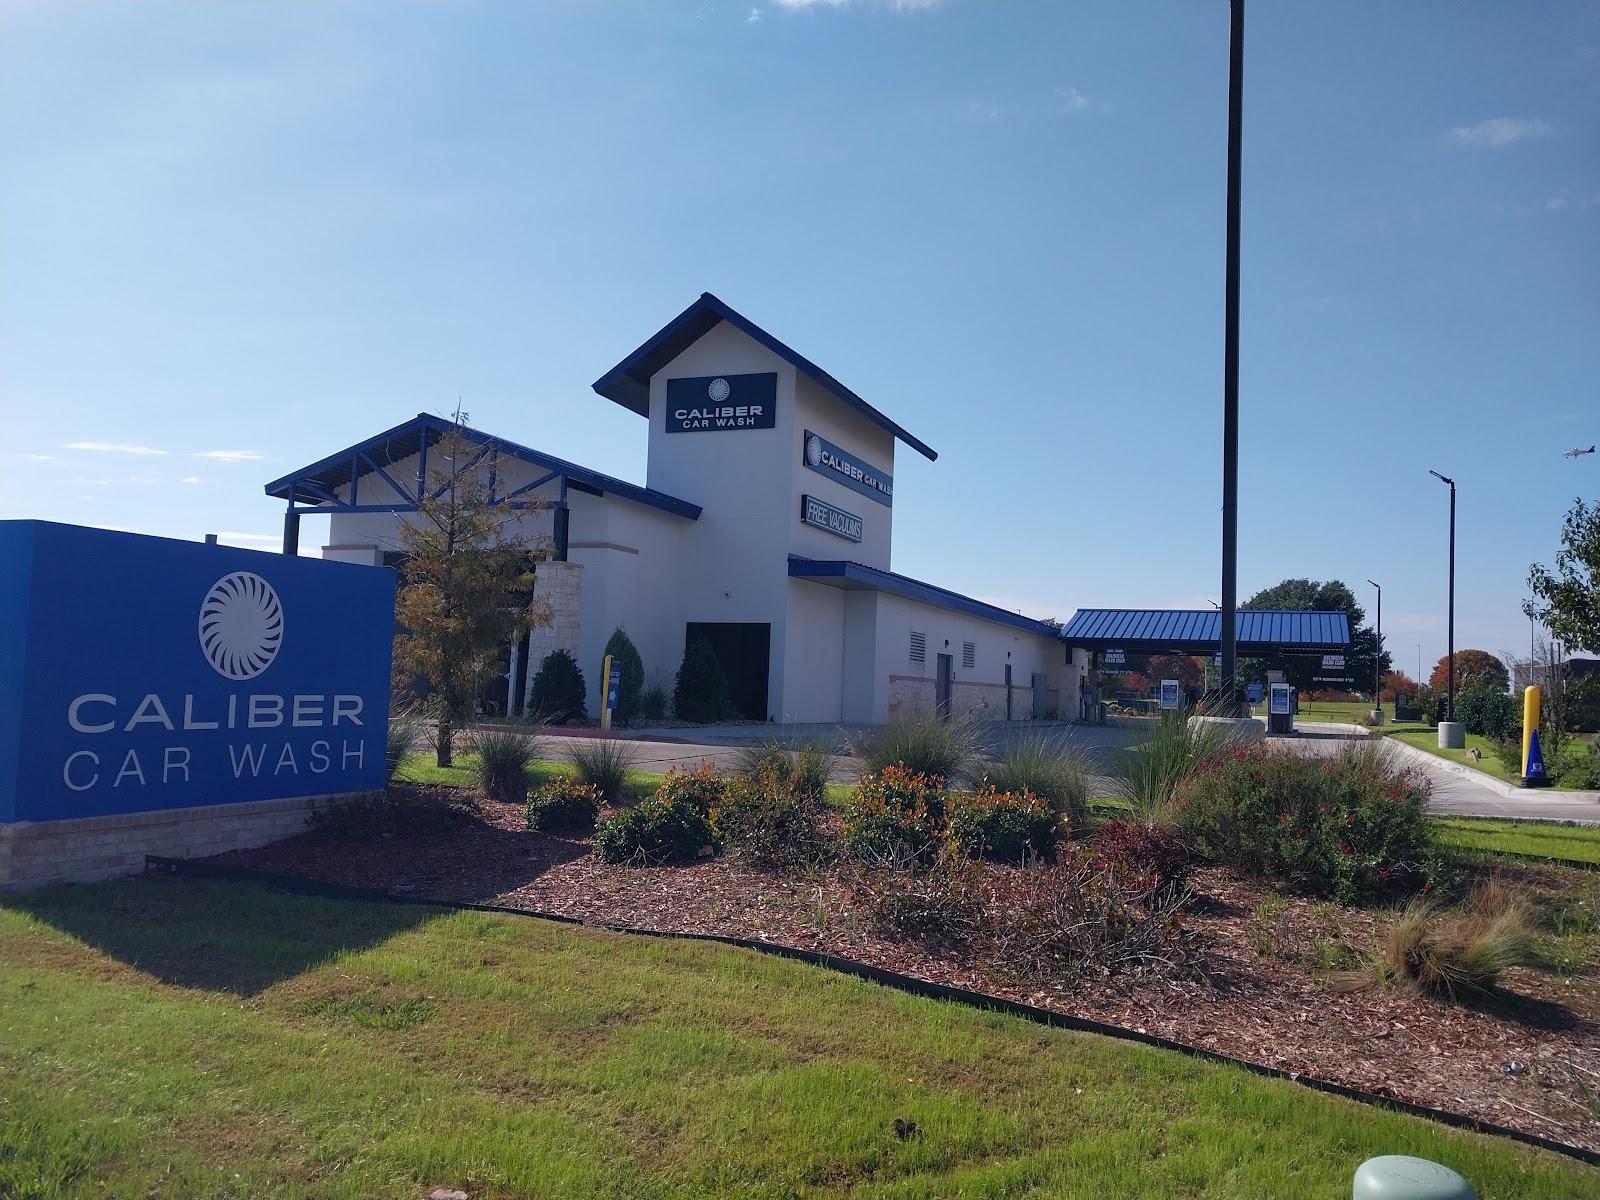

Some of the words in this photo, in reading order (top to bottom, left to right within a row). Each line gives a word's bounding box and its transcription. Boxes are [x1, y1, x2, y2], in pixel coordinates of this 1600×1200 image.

[674, 405, 764, 419] CALIBER
[682, 419, 710, 429] CAR
[716, 417, 755, 427] WASH
[821, 450, 863, 482] CALIBER
[864, 474, 877, 488] CAR
[808, 502, 828, 525] FREE
[829, 510, 862, 538] VACUUMS
[67, 693, 365, 734] CALIBER
[63, 746, 192, 791] CAR
[228, 738, 365, 779] WASH
